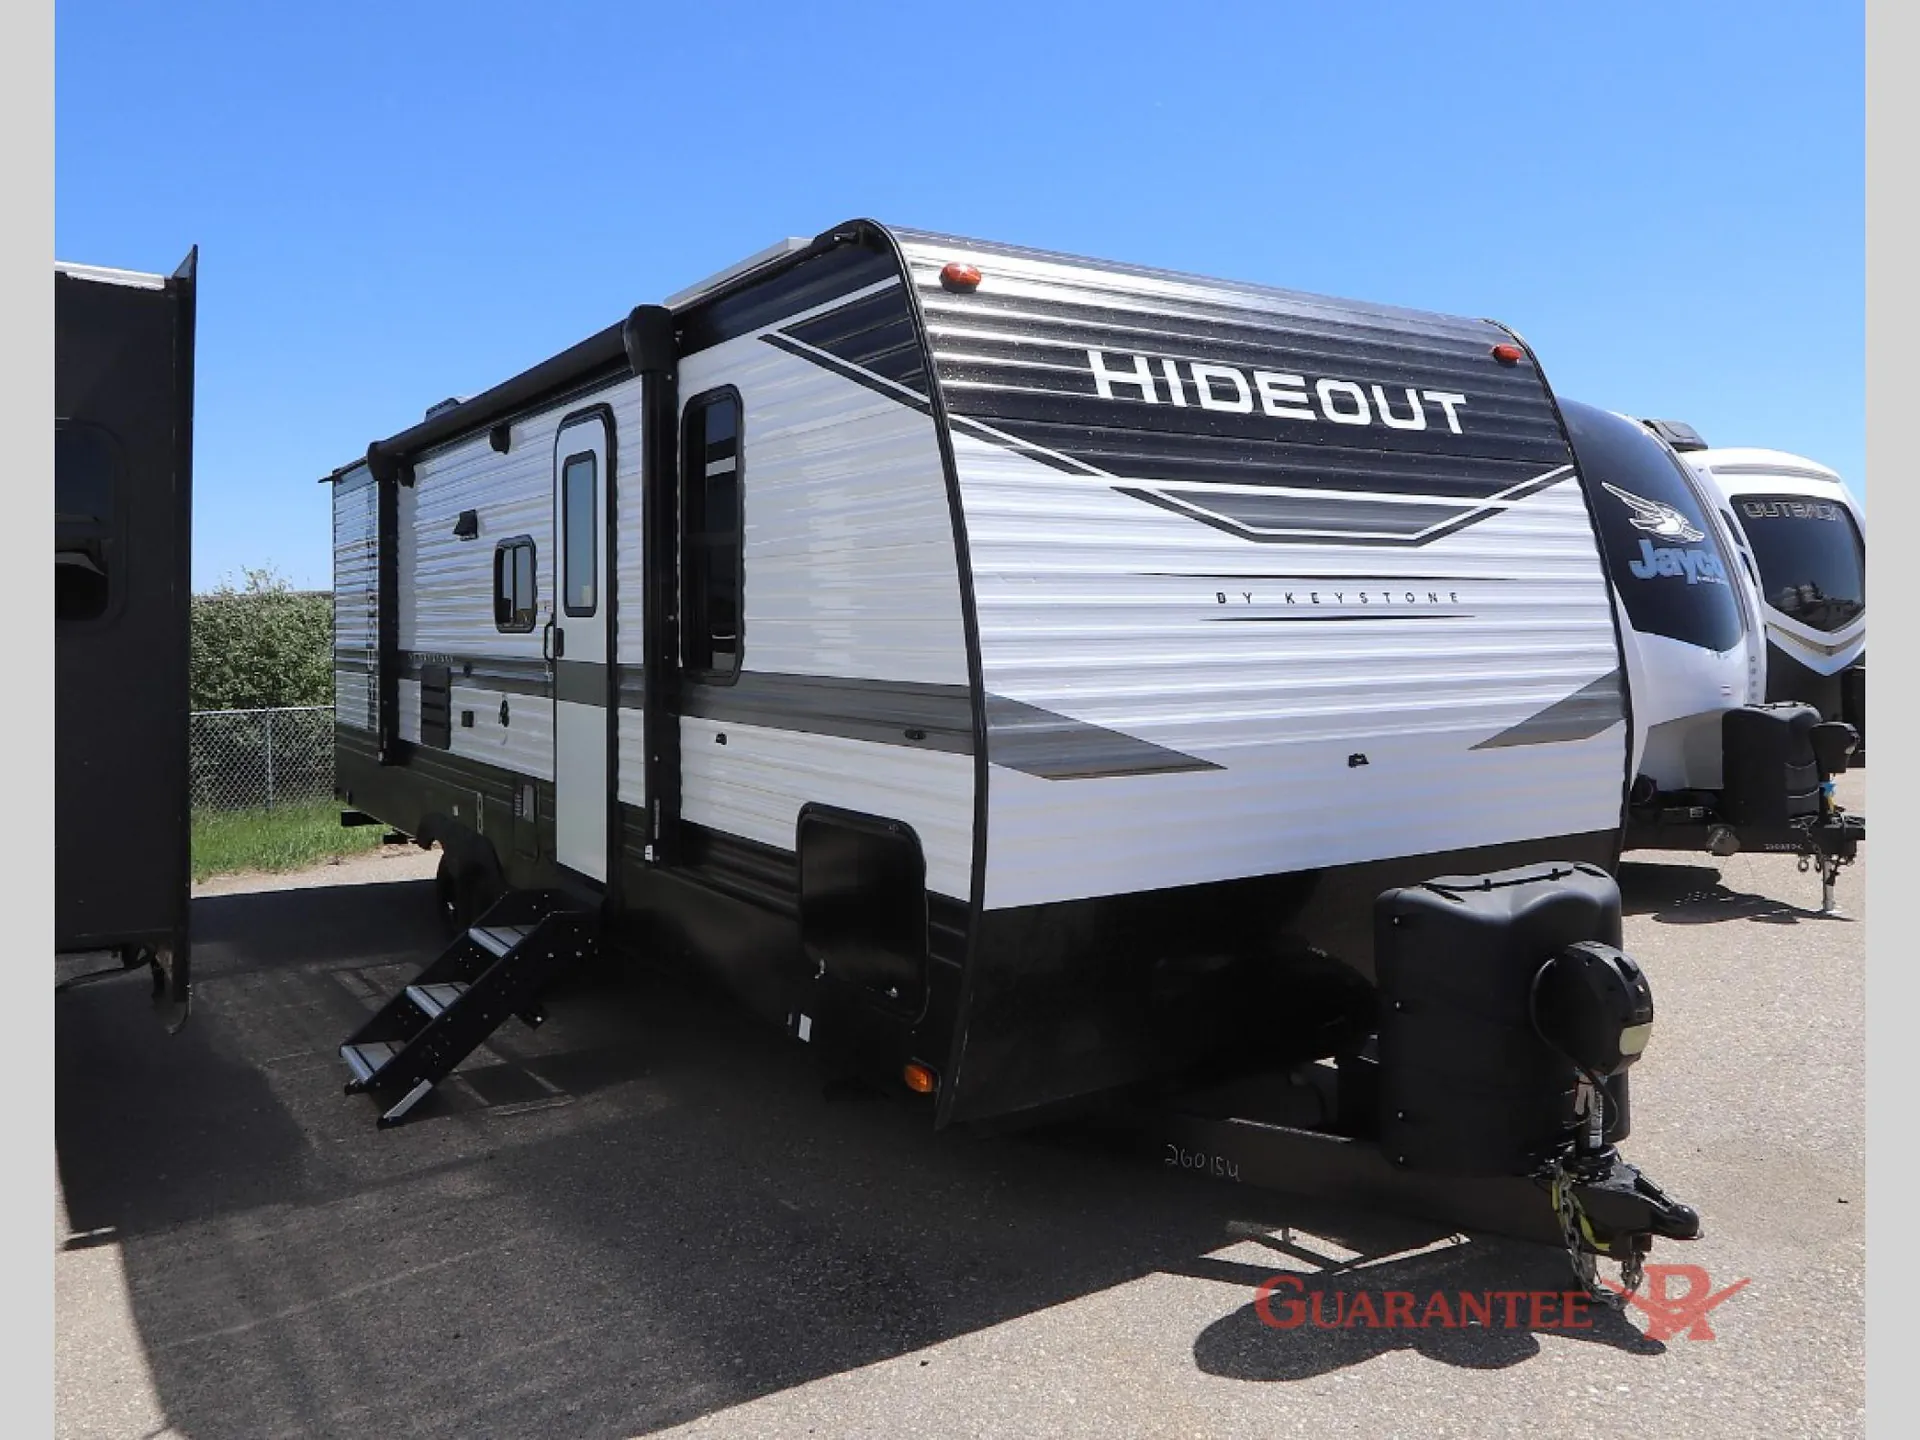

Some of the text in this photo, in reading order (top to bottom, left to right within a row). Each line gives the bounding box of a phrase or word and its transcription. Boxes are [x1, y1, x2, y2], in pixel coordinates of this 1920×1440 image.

[1087, 350, 1467, 434] HIDEOUT
[1216, 591, 1459, 604] BY KEYSTONE
